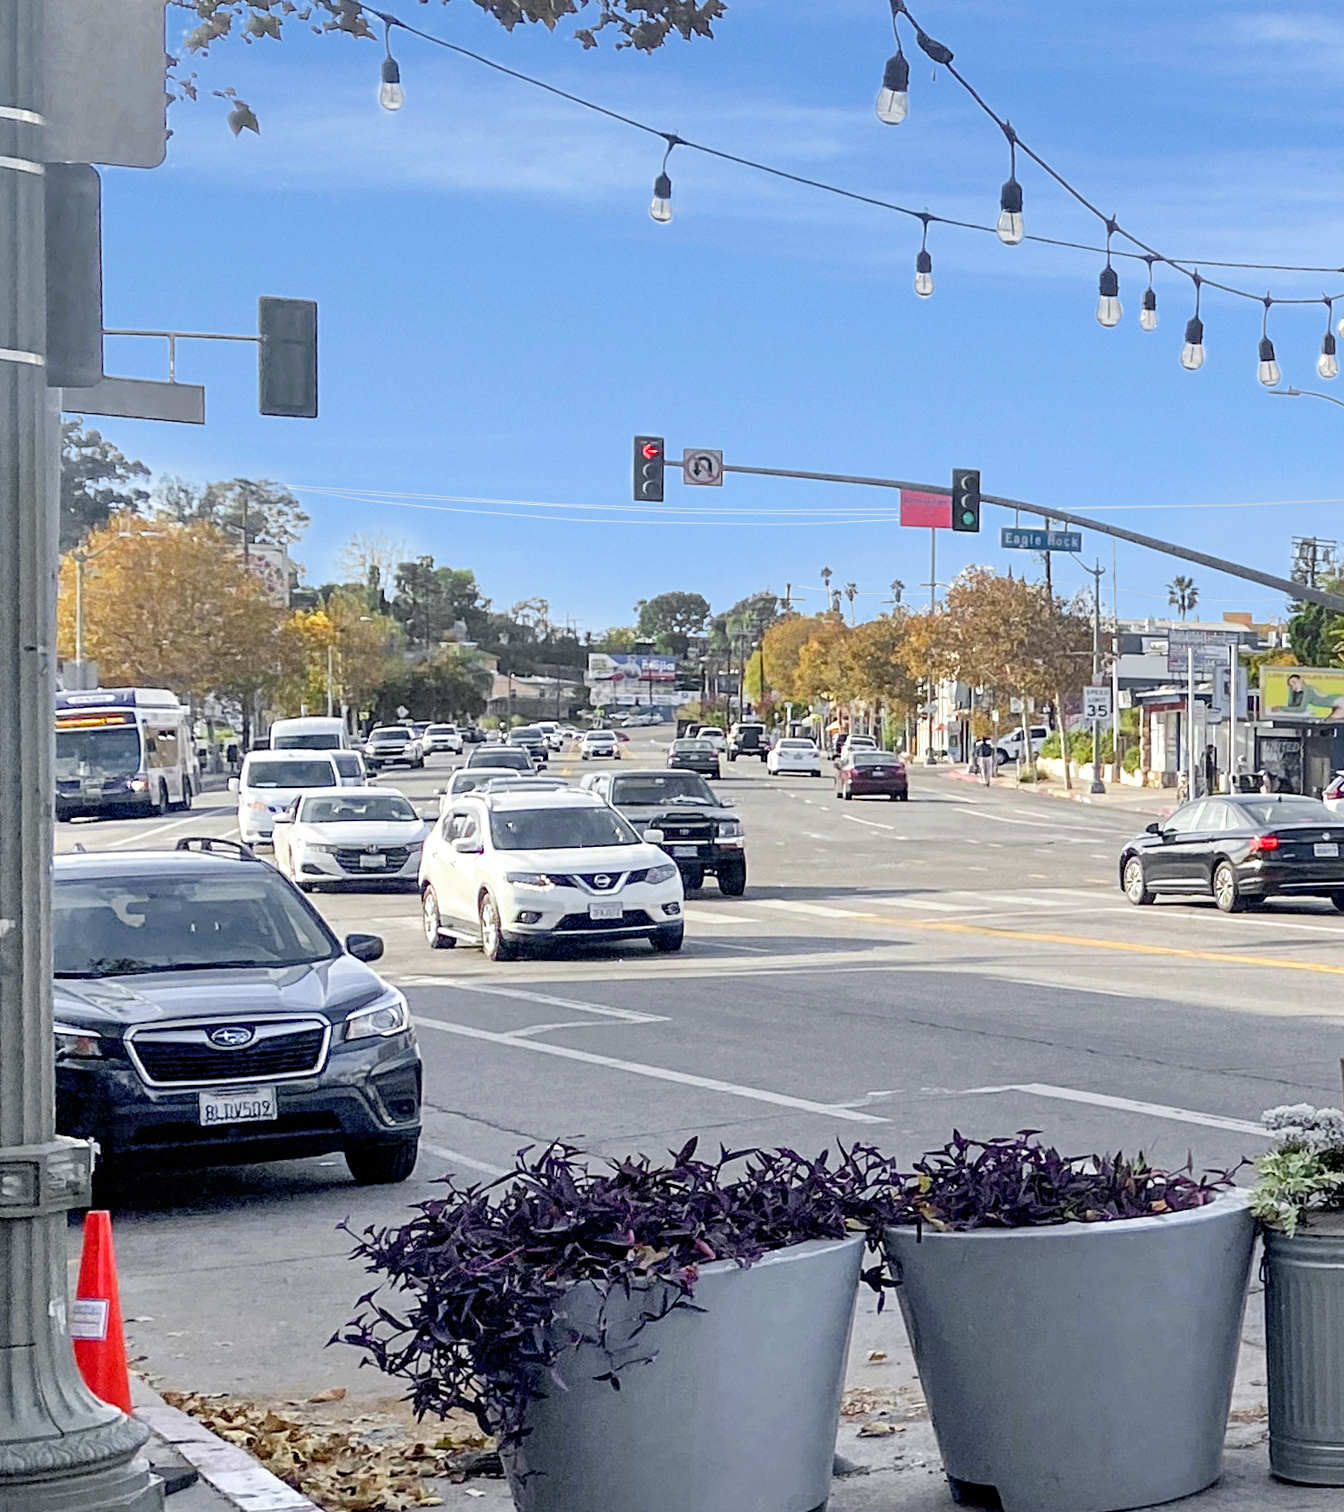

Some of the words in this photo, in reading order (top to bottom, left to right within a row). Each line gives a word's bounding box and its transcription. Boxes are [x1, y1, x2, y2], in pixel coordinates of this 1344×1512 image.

[1004, 532, 1042, 548] Eagle
[1047, 532, 1079, 548] Rock
[1087, 704, 1108, 717] 35
